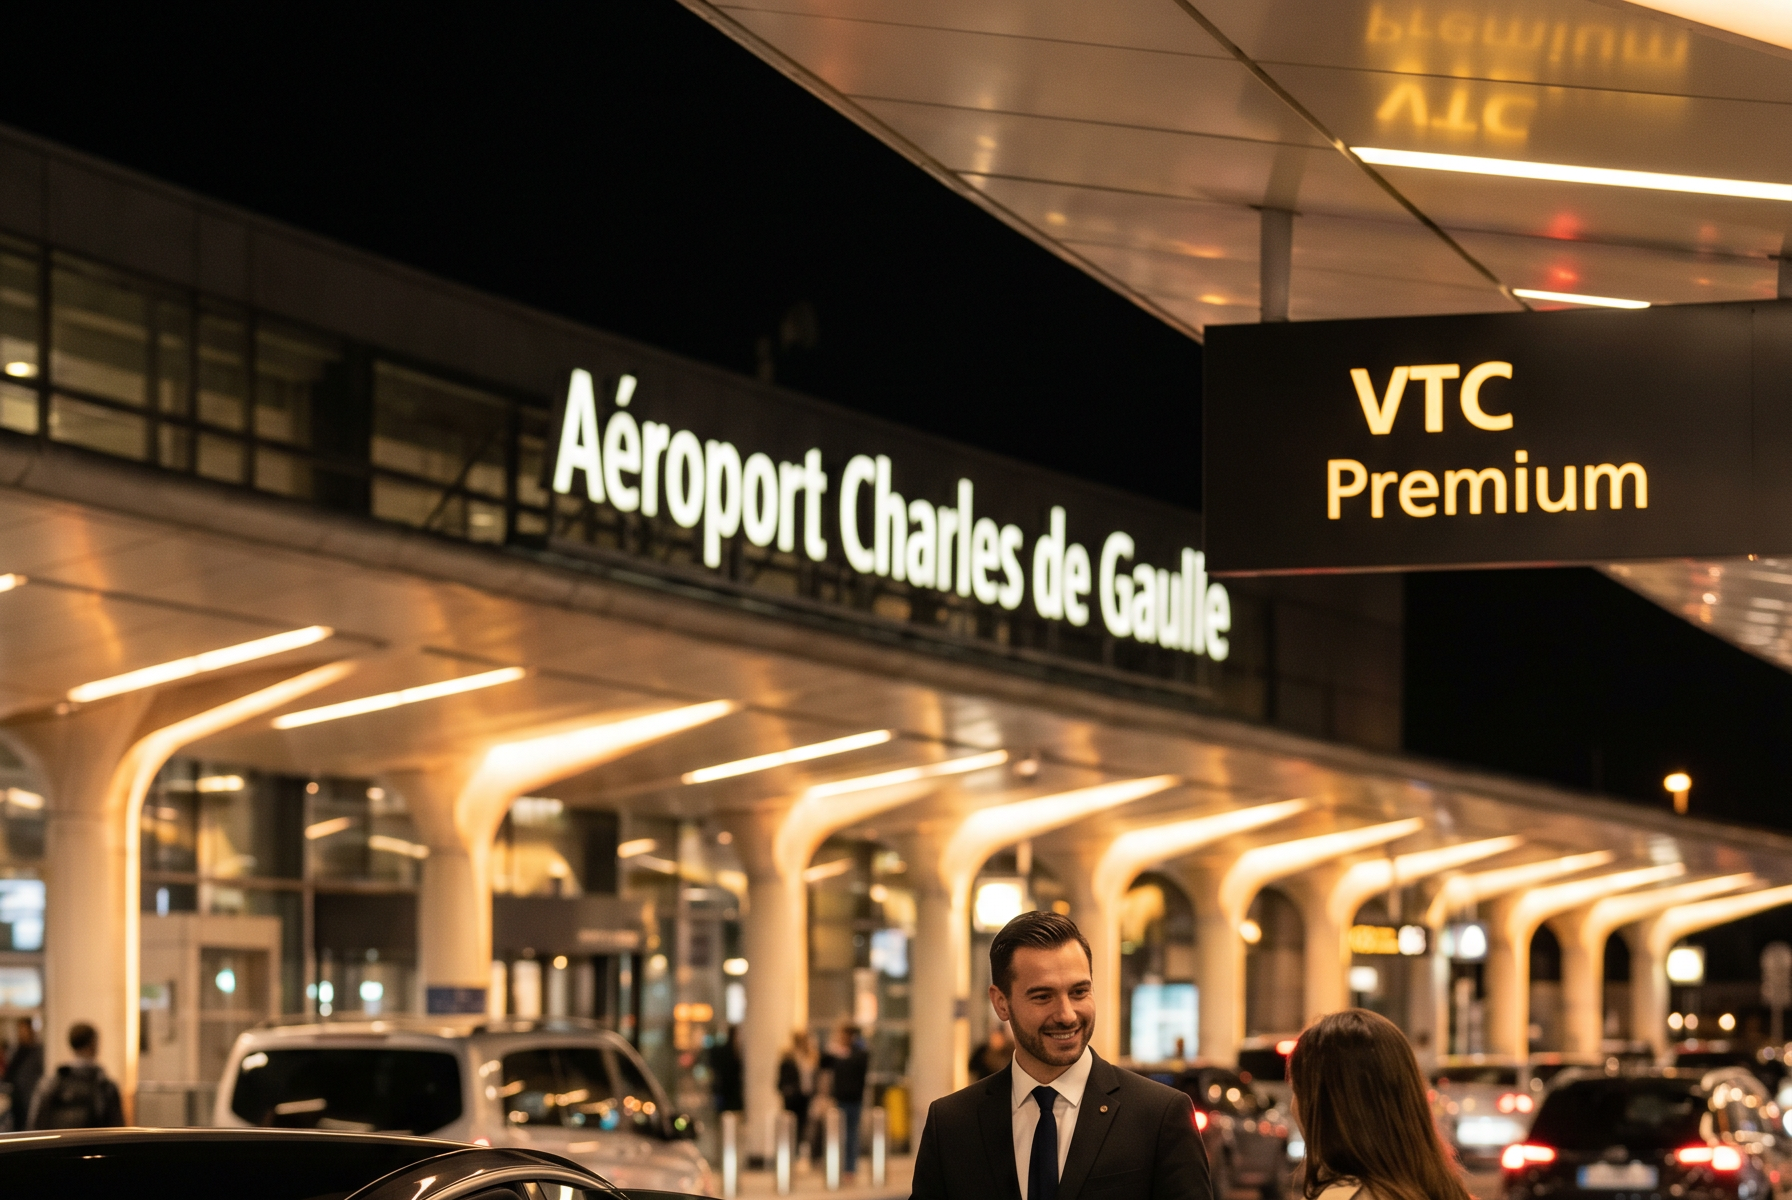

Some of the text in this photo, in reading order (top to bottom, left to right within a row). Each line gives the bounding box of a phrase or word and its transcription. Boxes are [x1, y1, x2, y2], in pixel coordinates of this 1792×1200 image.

[1350, 360, 1514, 435] VTC
[553, 368, 1231, 662] Aéroport Charles de Gaulle
[1327, 449, 1649, 520] Premium
